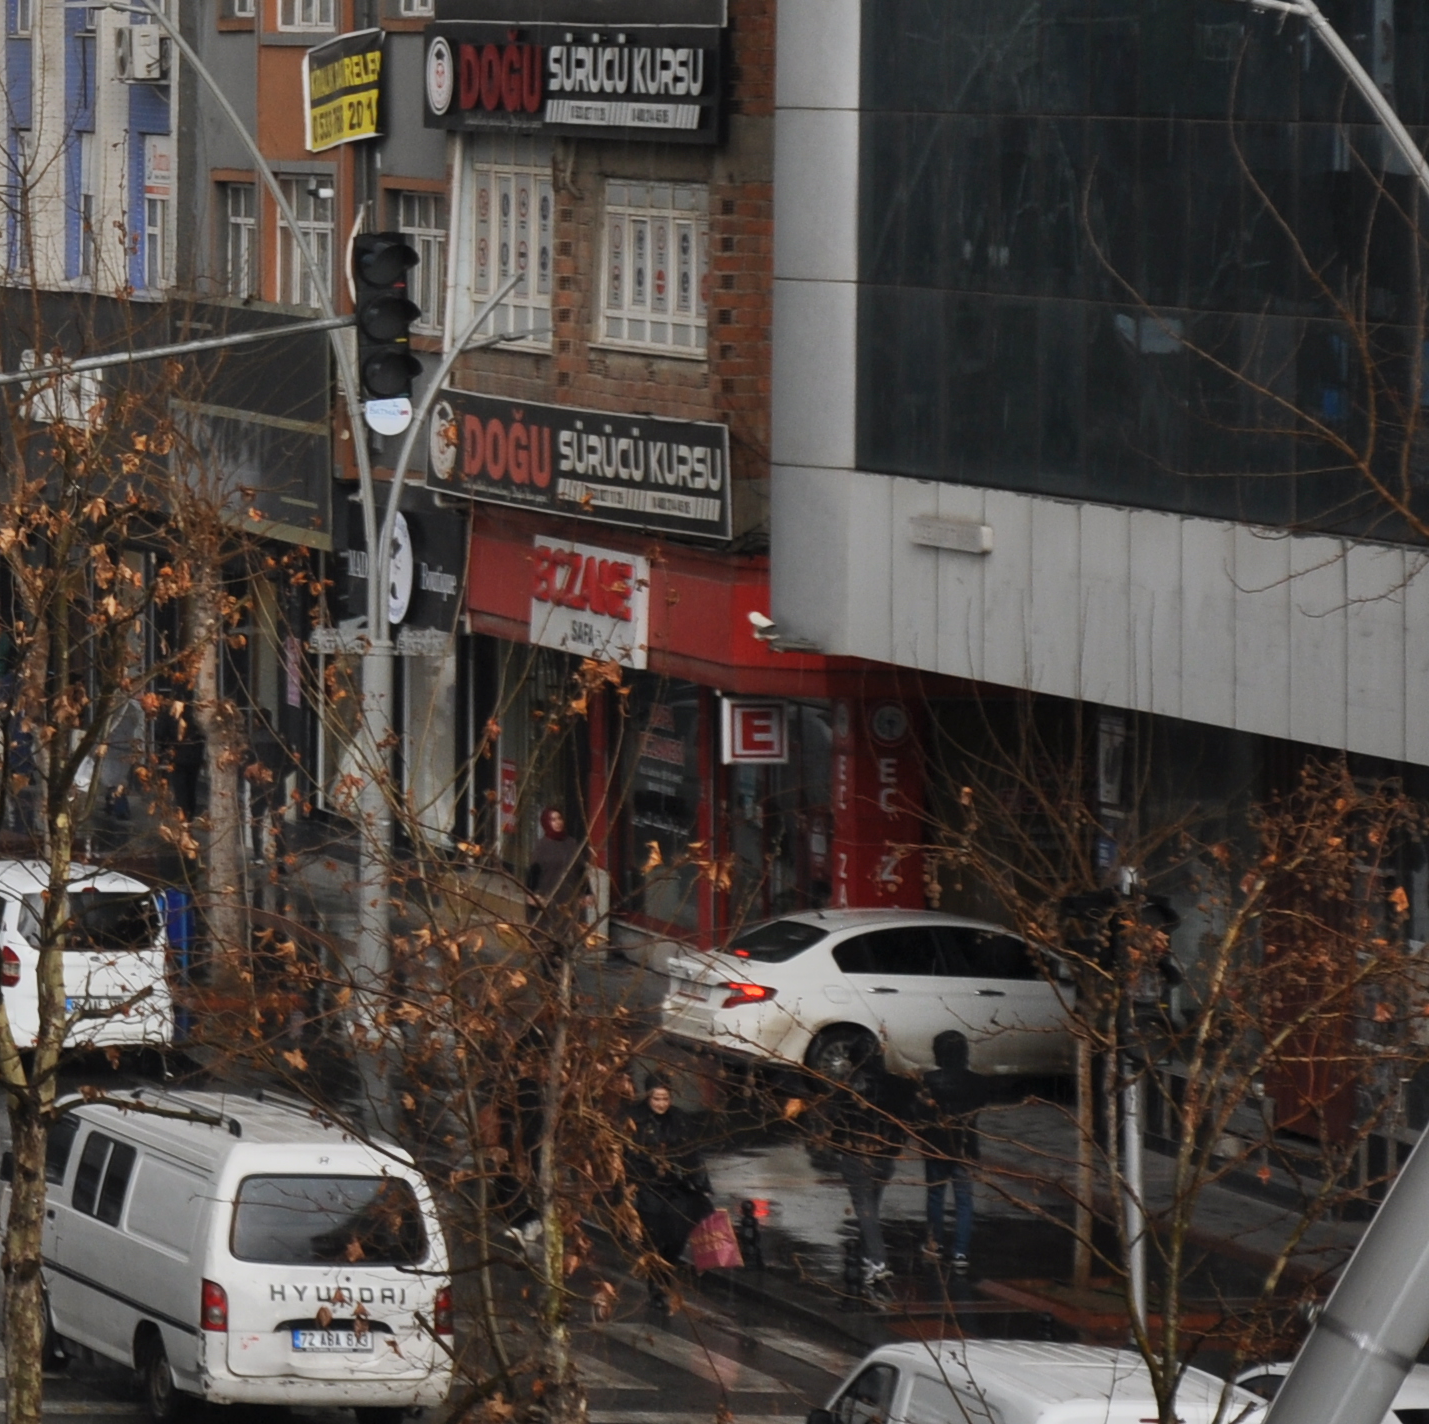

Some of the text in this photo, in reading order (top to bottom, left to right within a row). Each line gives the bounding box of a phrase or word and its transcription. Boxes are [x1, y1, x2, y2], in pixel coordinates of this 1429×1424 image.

[459, 29, 704, 113] DOĞU SÜRÜCÜ KURSU
[463, 408, 722, 492] DOĞU SÜRÜCÜ KURSU
